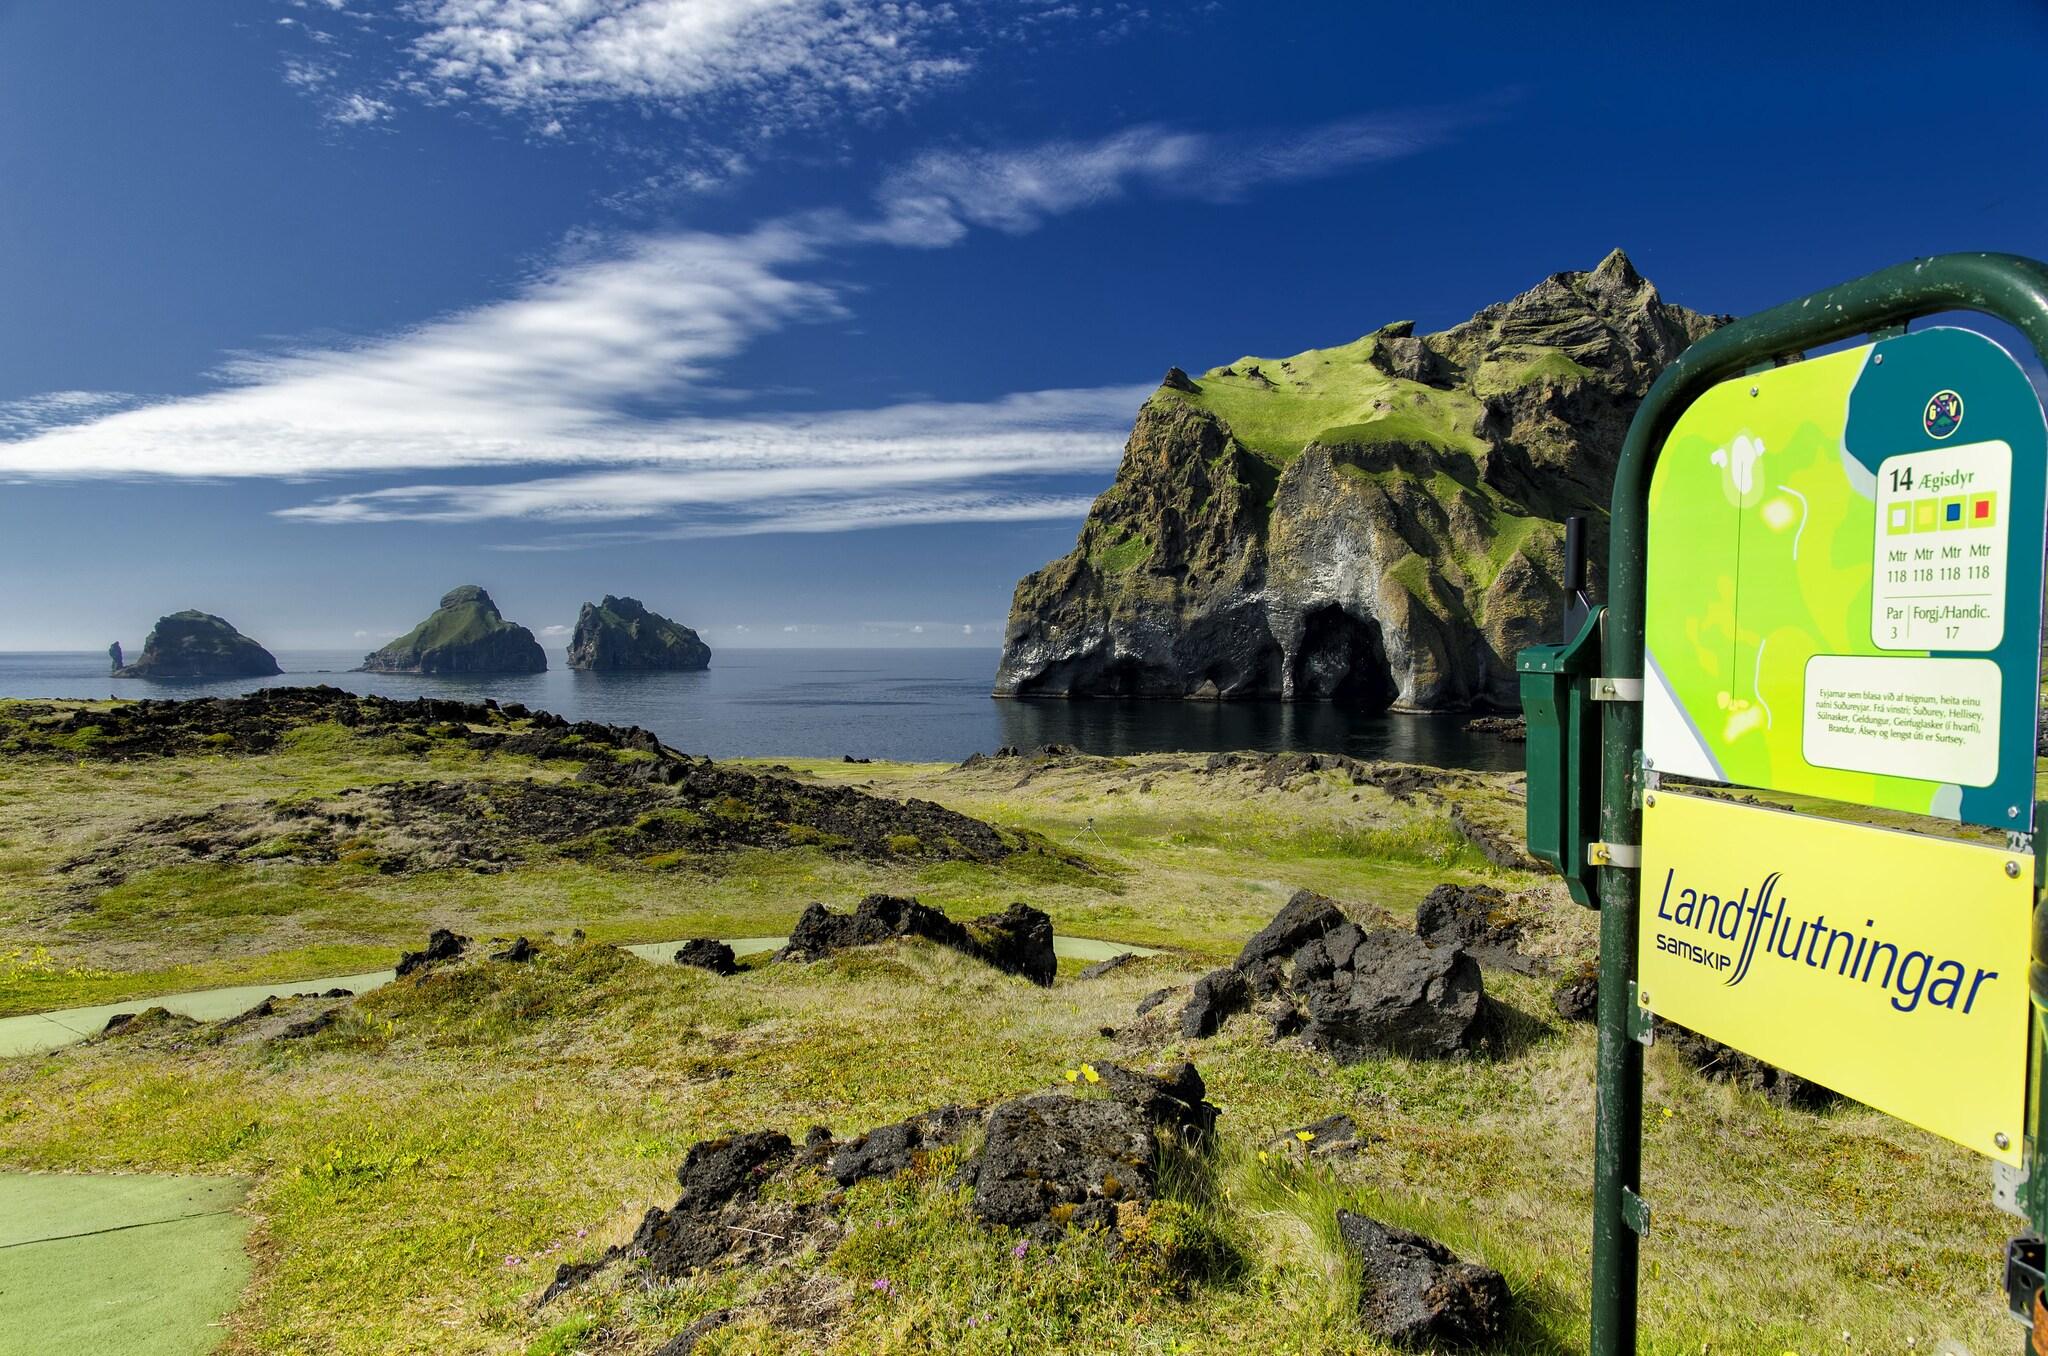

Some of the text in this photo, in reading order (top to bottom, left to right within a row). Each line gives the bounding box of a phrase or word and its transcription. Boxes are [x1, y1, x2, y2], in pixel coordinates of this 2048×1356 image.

[1890, 467, 1975, 493] 14 Ægisdyr
[1888, 544, 1991, 563] Mtr Mtr Mtr Mtr
[1888, 565, 1990, 583] 118 118 118 118
[1886, 607, 1903, 620] Par
[1890, 627, 1898, 639] 3
[1945, 627, 1960, 639] 17
[1940, 695, 1960, 705] heita
[1962, 697, 1981, 706] einu
[1879, 730, 1889, 740] og
[1925, 733, 1934, 741] er
